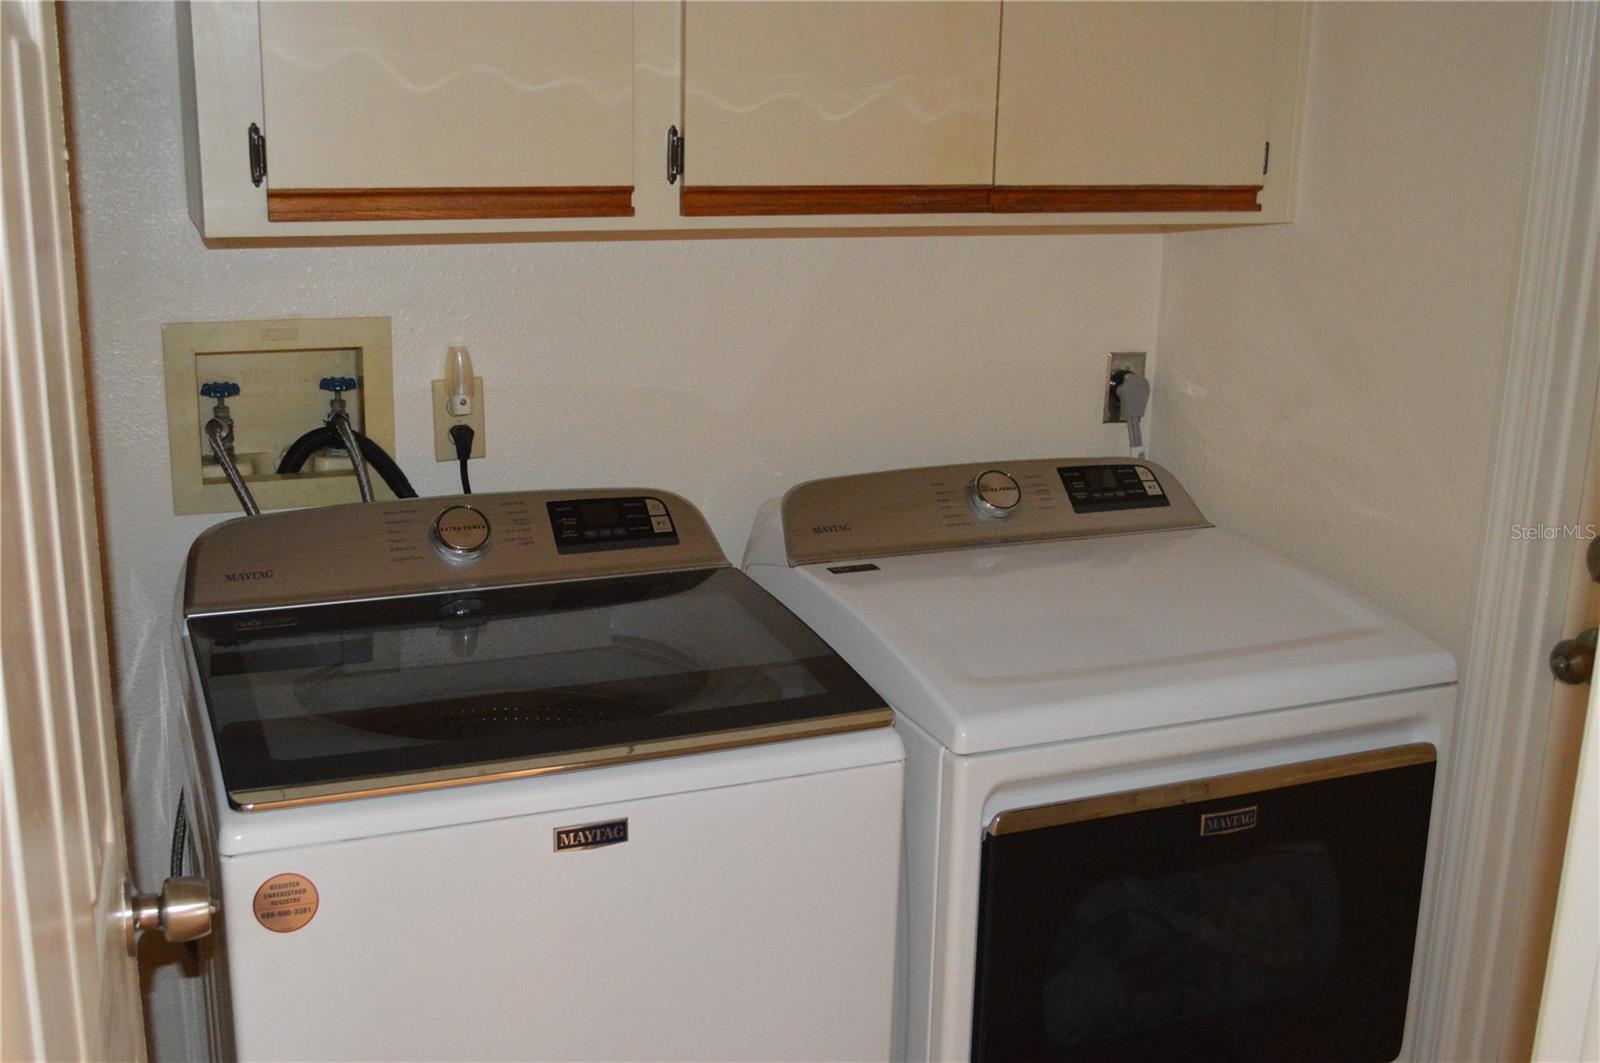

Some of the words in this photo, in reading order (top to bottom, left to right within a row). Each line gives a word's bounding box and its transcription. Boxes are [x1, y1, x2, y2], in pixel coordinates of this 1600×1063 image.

[812, 524, 851, 534] MAYTAG
[224, 570, 273, 582] MAYTAG
[560, 825, 624, 847] MAYTAG
